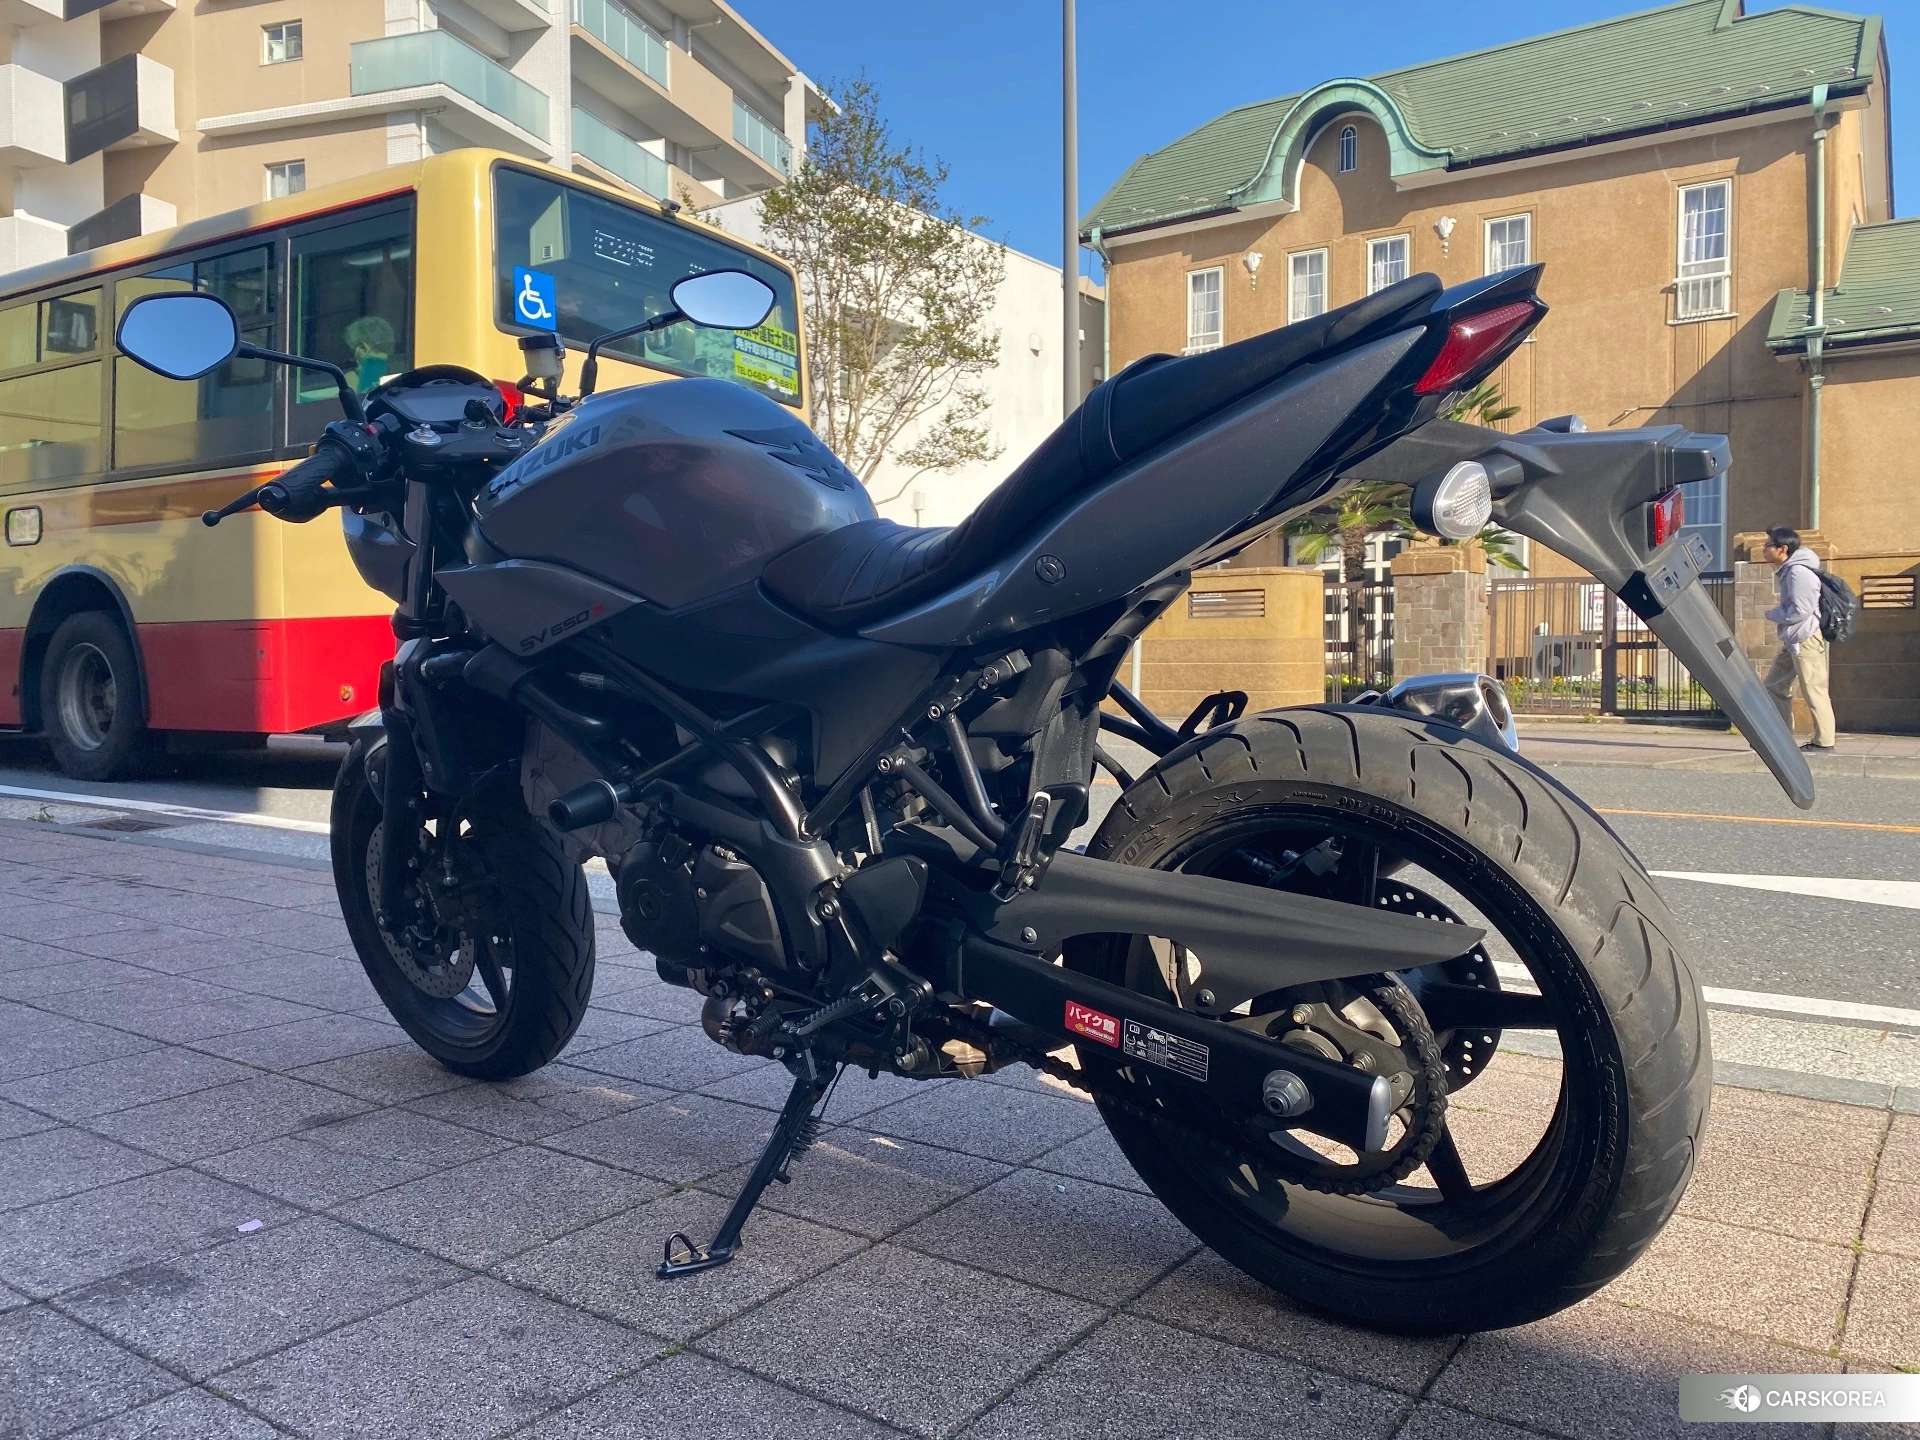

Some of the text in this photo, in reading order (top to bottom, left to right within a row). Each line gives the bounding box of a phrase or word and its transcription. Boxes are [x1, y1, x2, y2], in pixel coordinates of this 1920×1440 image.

[736, 365, 747, 376] TEL
[487, 425, 602, 501] SUZUKI
[519, 602, 606, 652] SV650X
[1069, 1006, 1116, 1034] バイク館
